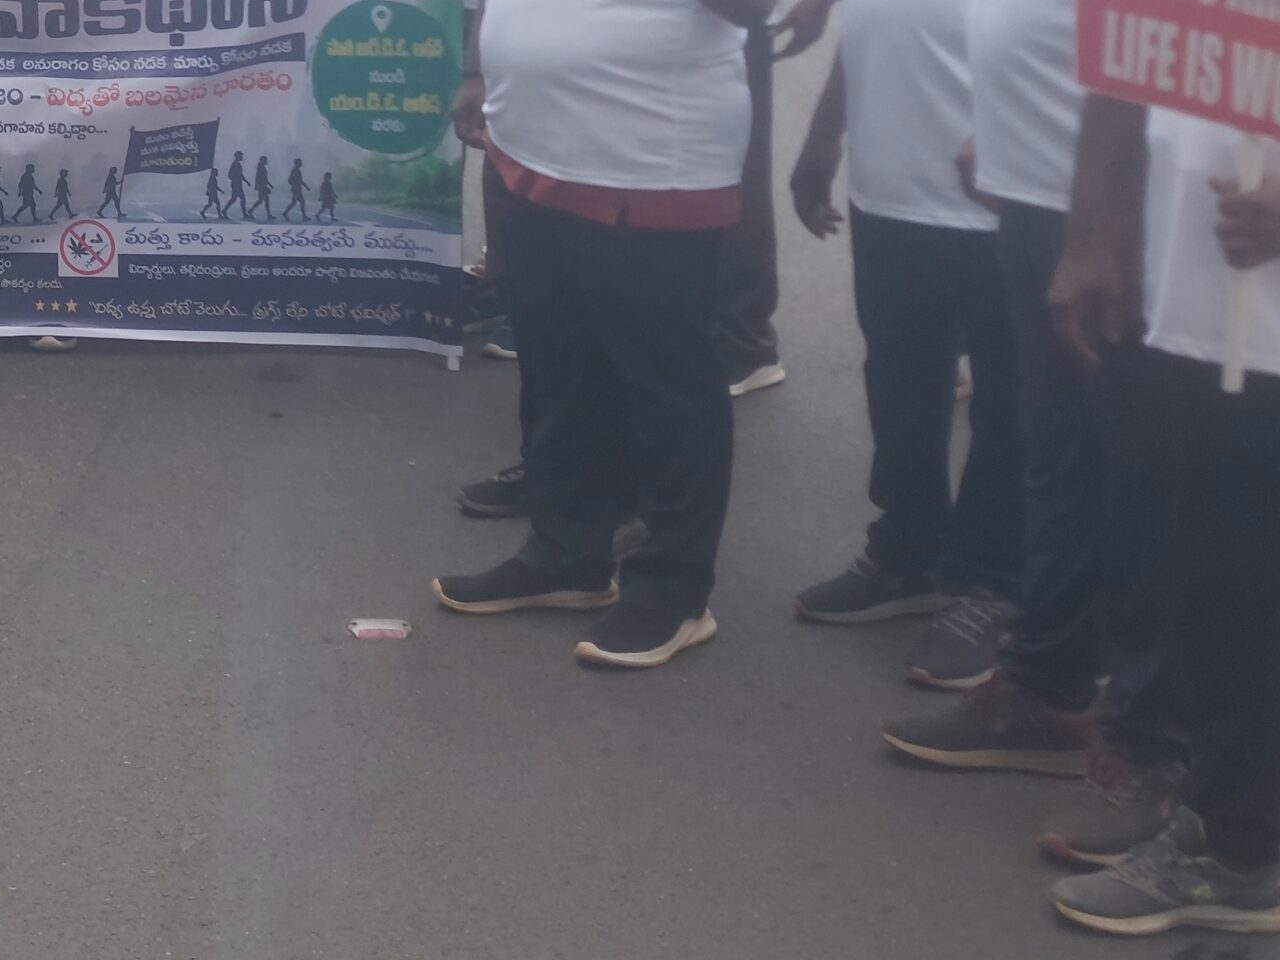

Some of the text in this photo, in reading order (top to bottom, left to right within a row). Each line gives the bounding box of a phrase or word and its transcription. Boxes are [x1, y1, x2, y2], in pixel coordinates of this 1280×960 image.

[22, 58, 88, 71] అనురాగం
[92, 57, 130, 72] కోసం
[133, 57, 167, 71] నడక
[221, 49, 258, 66] కోసం
[260, 40, 293, 57] నడక
[1104, 9, 1180, 93] LIFE
[1183, 28, 1225, 106] IS
[47, 83, 120, 116] విద్యతో
[125, 83, 208, 111] బలమైన
[213, 71, 293, 97] భారతం
[125, 227, 172, 250] మత్తు
[179, 228, 224, 246] కాదు
[251, 228, 356, 252] మానవత్వమే
[127, 299, 156, 318] ఉన్న
